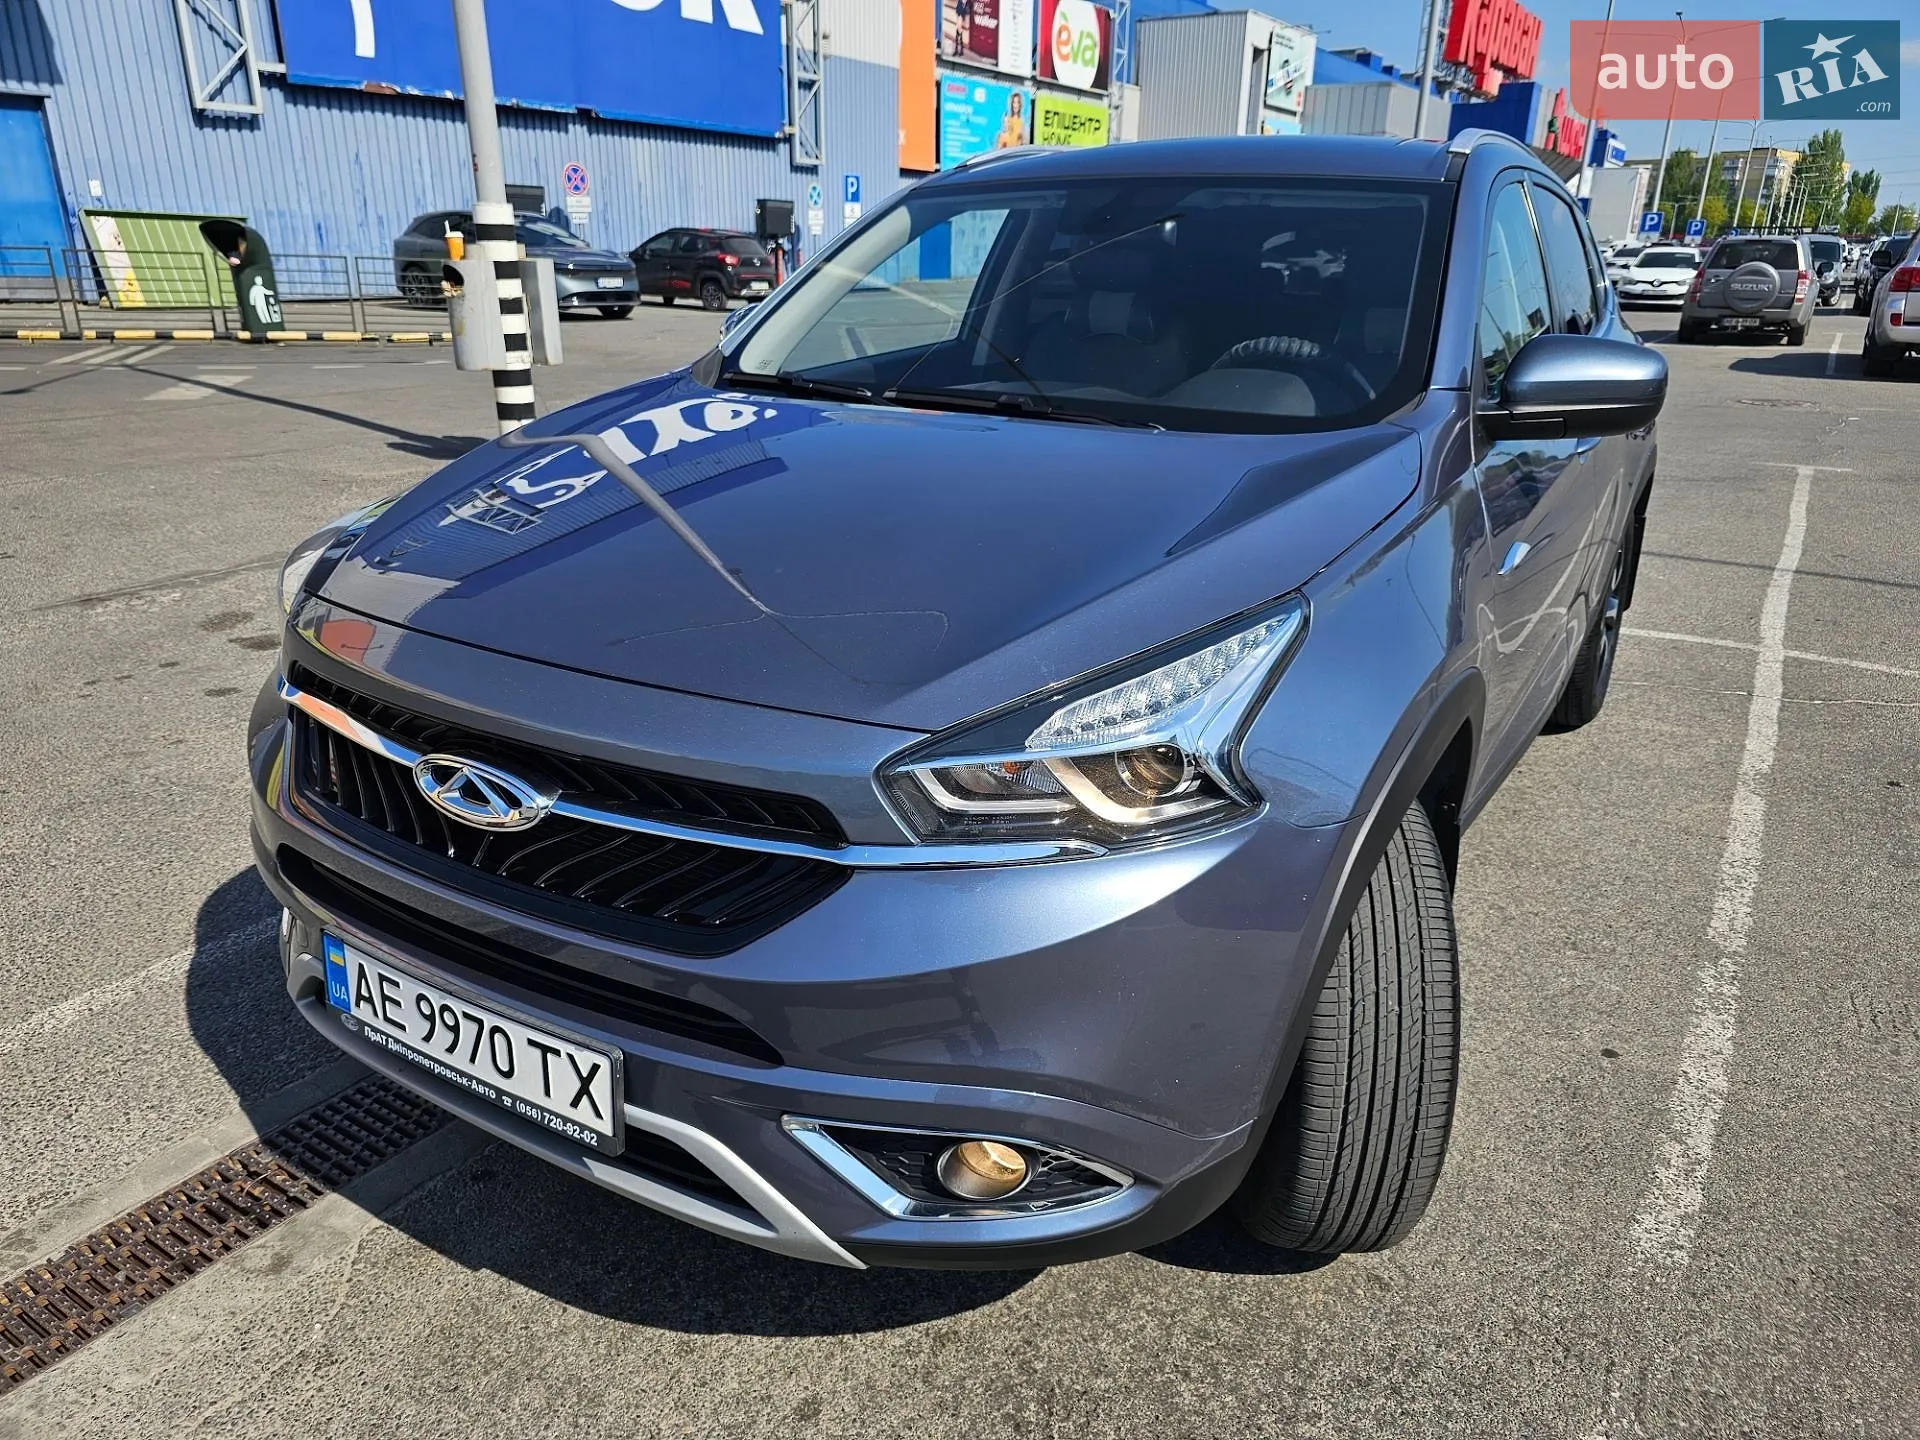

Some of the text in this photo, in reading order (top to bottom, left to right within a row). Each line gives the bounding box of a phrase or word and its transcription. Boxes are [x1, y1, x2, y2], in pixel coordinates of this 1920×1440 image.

[1056, 22, 1096, 68] eva
[1044, 110, 1101, 137] ЕПІЦЕНТР
[847, 177, 858, 199] P
[1644, 214, 1658, 231] P
[1690, 221, 1701, 235] P
[1730, 283, 1773, 291] SUZUKI
[332, 981, 349, 1002] UA
[354, 960, 605, 1120] AE 9970 TX
[364, 1026, 598, 1146] ПрАТ Дніпропетровськ-Авто (056) 720-92-02
